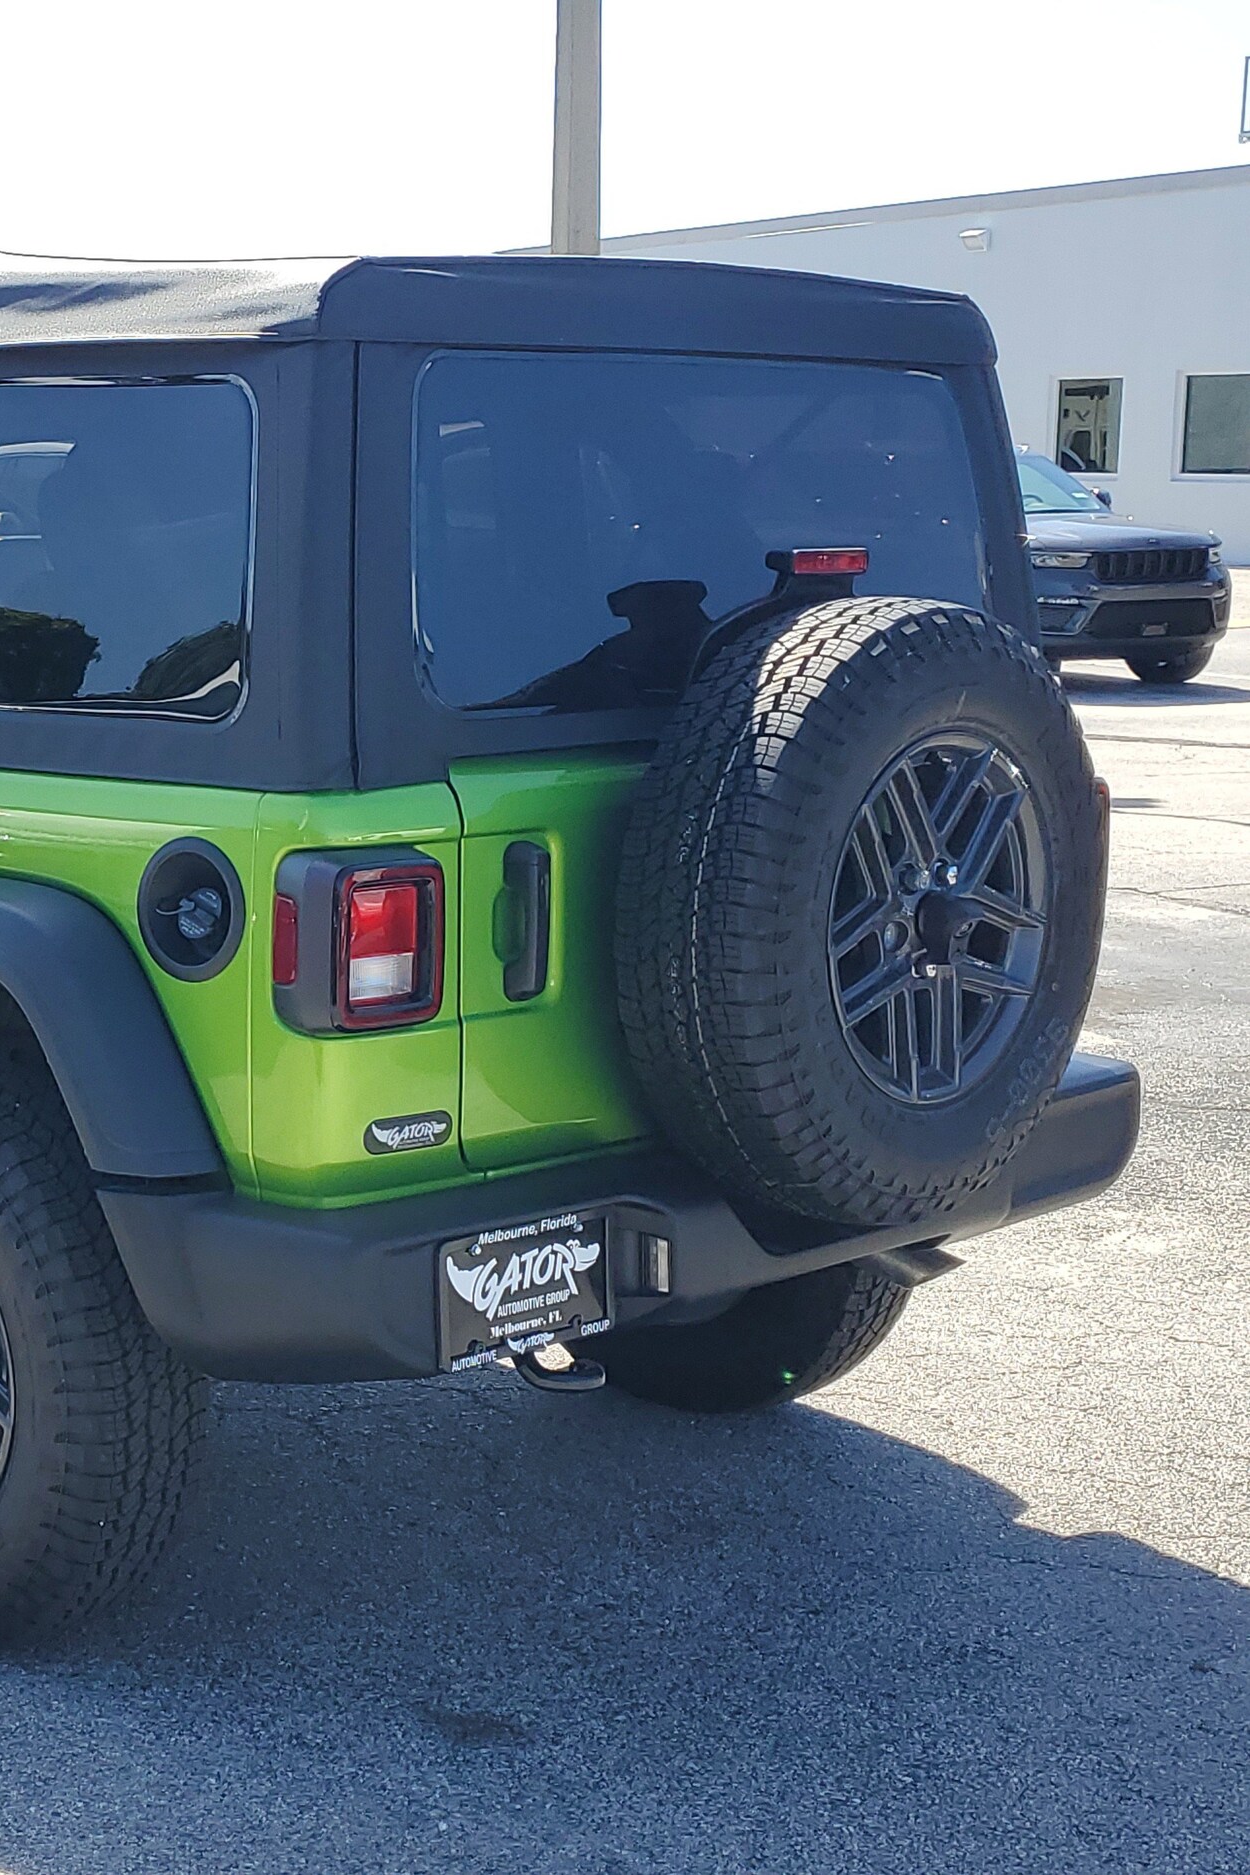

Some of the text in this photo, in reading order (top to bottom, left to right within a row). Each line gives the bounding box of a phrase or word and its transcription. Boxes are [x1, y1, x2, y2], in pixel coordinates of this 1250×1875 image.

[387, 1122, 435, 1149] GATOR
[478, 1214, 577, 1245] Melbourne, Florida
[474, 1243, 578, 1321] GATOR
[497, 1289, 570, 1318] AUTOMOTIVE GROUP
[490, 1310, 562, 1339] Melbourne, FL
[581, 1319, 610, 1336] GROUP
[452, 1350, 497, 1372] AUTOMOTIVE
